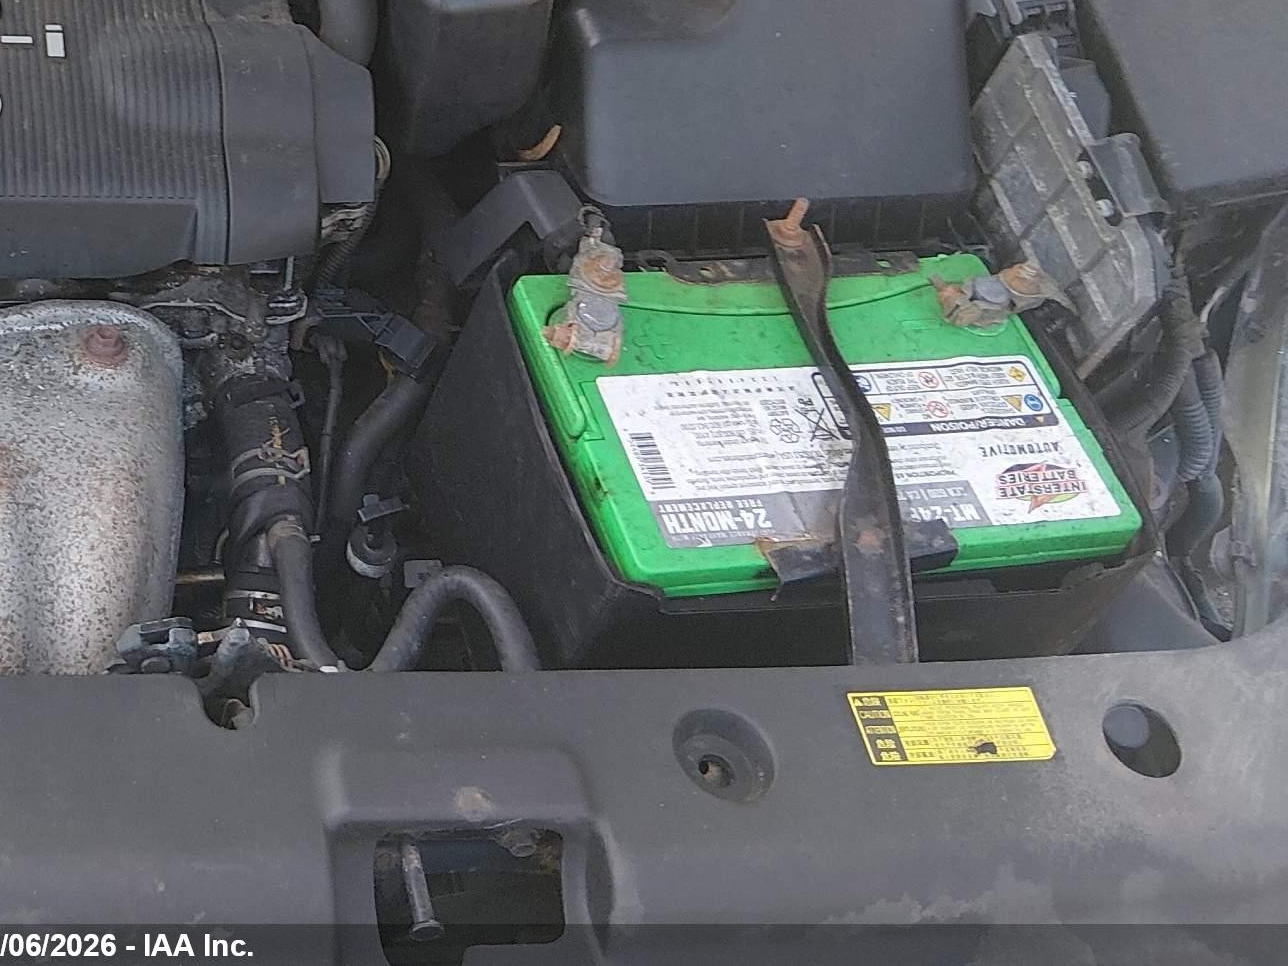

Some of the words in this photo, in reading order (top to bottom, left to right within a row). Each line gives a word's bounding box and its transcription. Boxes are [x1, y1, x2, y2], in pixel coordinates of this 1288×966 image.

[929, 416, 1026, 434] DANGER/POISON
[977, 440, 1059, 458] AUTOMOTIVE
[998, 469, 1077, 485] BATTERIES
[998, 480, 1087, 498] INTERSTATE
[657, 499, 734, 514] REPLACEMENT
[735, 498, 764, 509] FREE
[660, 508, 773, 535] 24-MONTH
